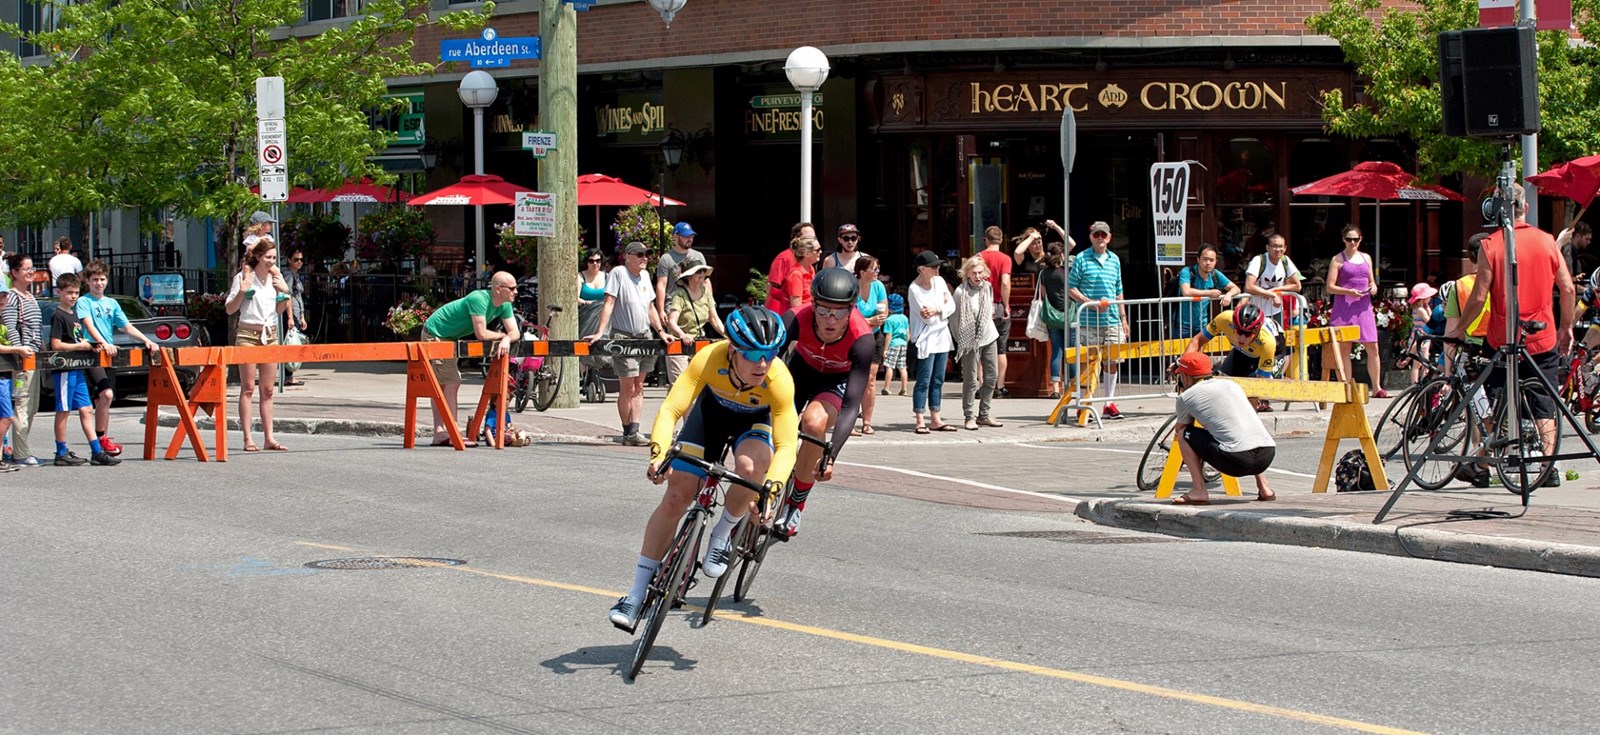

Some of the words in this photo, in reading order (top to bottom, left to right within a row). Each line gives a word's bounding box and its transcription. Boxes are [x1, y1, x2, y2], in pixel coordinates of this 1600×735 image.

[448, 49, 461, 57] rue
[465, 41, 518, 56] Aberdeen
[521, 45, 531, 54] St.
[760, 95, 801, 106] PURVEYO
[1140, 81, 1288, 112] CROWN
[528, 136, 551, 146] FIRENZE
[1153, 167, 1186, 214] 150
[1156, 216, 1183, 237] meters
